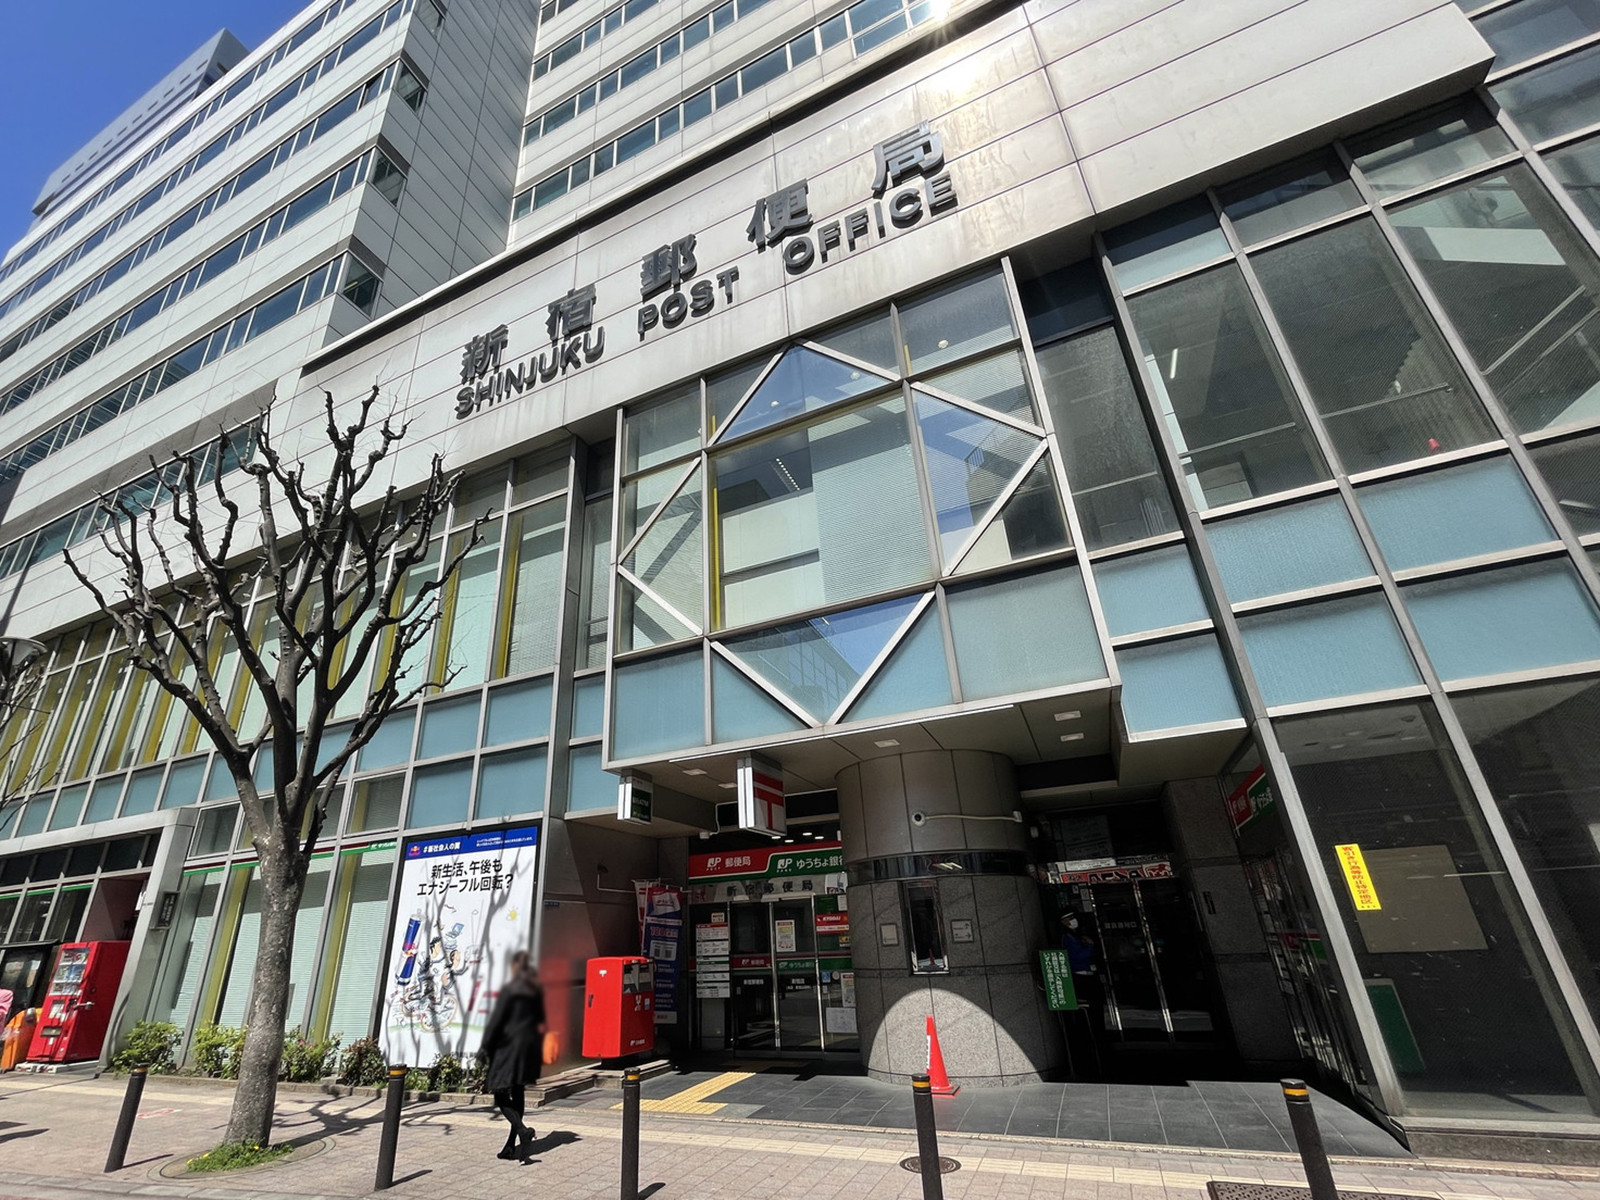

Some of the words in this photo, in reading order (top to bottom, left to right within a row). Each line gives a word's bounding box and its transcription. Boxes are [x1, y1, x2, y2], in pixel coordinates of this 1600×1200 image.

[455, 326, 605, 419] SHINJUKU
[638, 266, 740, 341] POST
[783, 171, 958, 275] OFFICE
[461, 121, 945, 384] 新宿郵便局
[431, 859, 503, 879] 新生活、午後も
[725, 856, 751, 868] 郵便局
